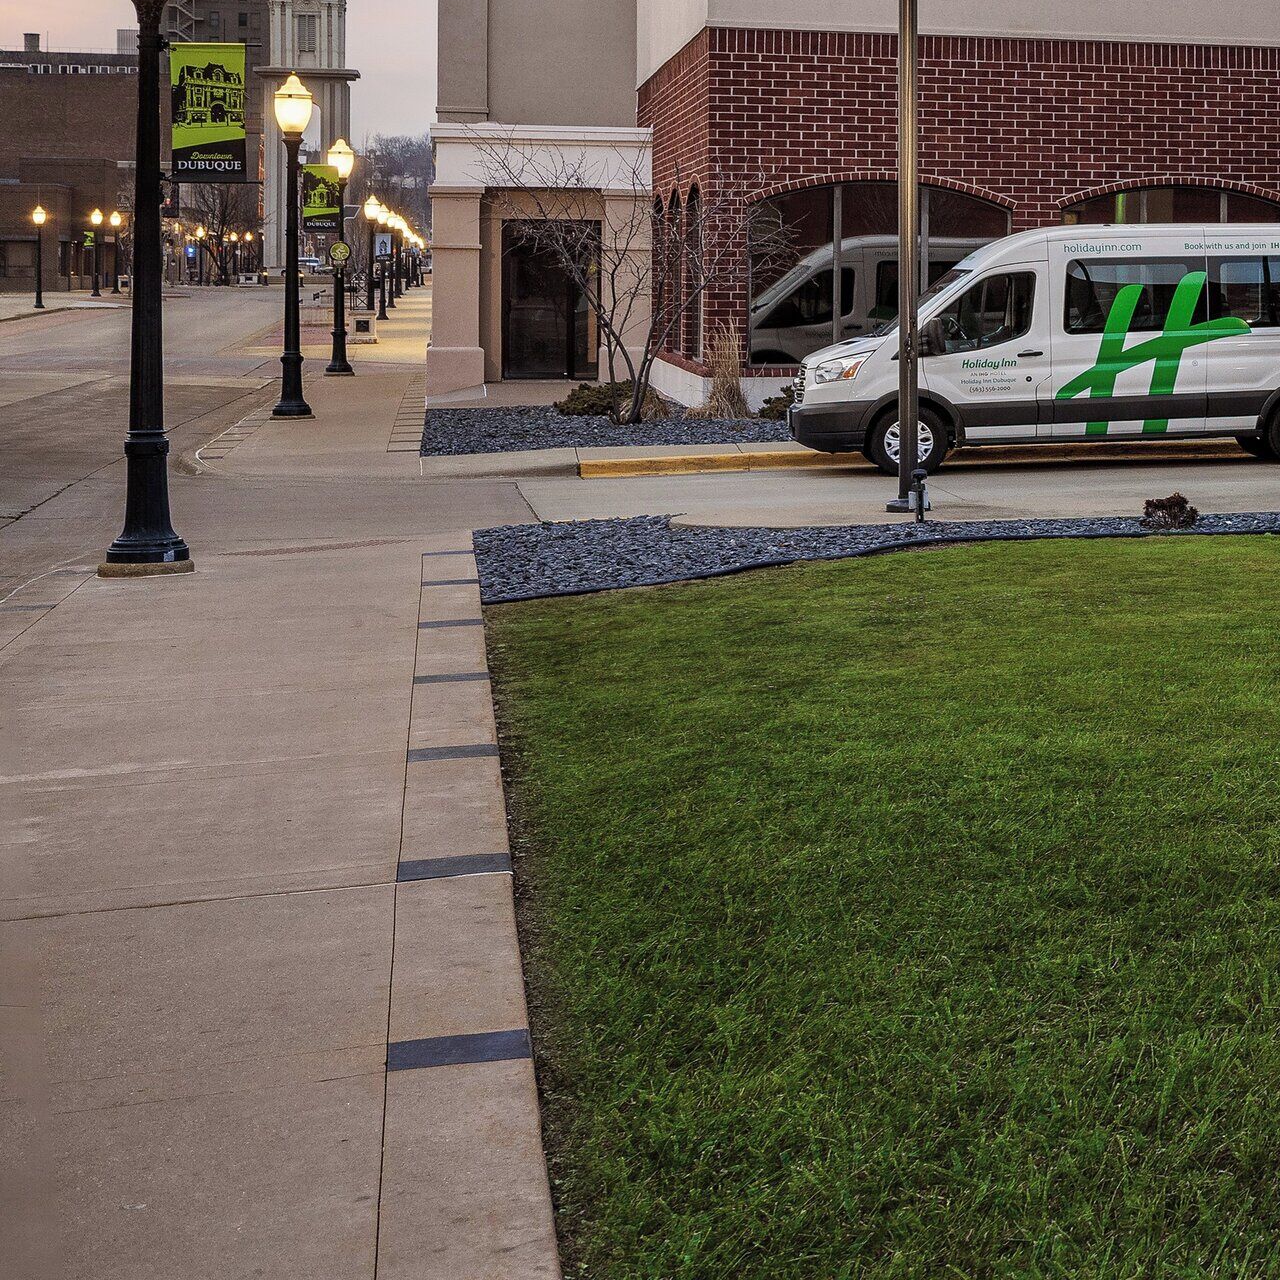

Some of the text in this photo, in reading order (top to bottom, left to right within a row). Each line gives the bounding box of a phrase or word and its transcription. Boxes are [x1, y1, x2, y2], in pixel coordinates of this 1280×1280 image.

[190, 151, 233, 160] Downtown
[178, 160, 242, 172] DUBUQUE
[1063, 243, 1142, 254] holidayinn.com
[1206, 242, 1223, 250] with
[1252, 241, 1267, 251] join
[962, 358, 1017, 369] Holiday Inn
